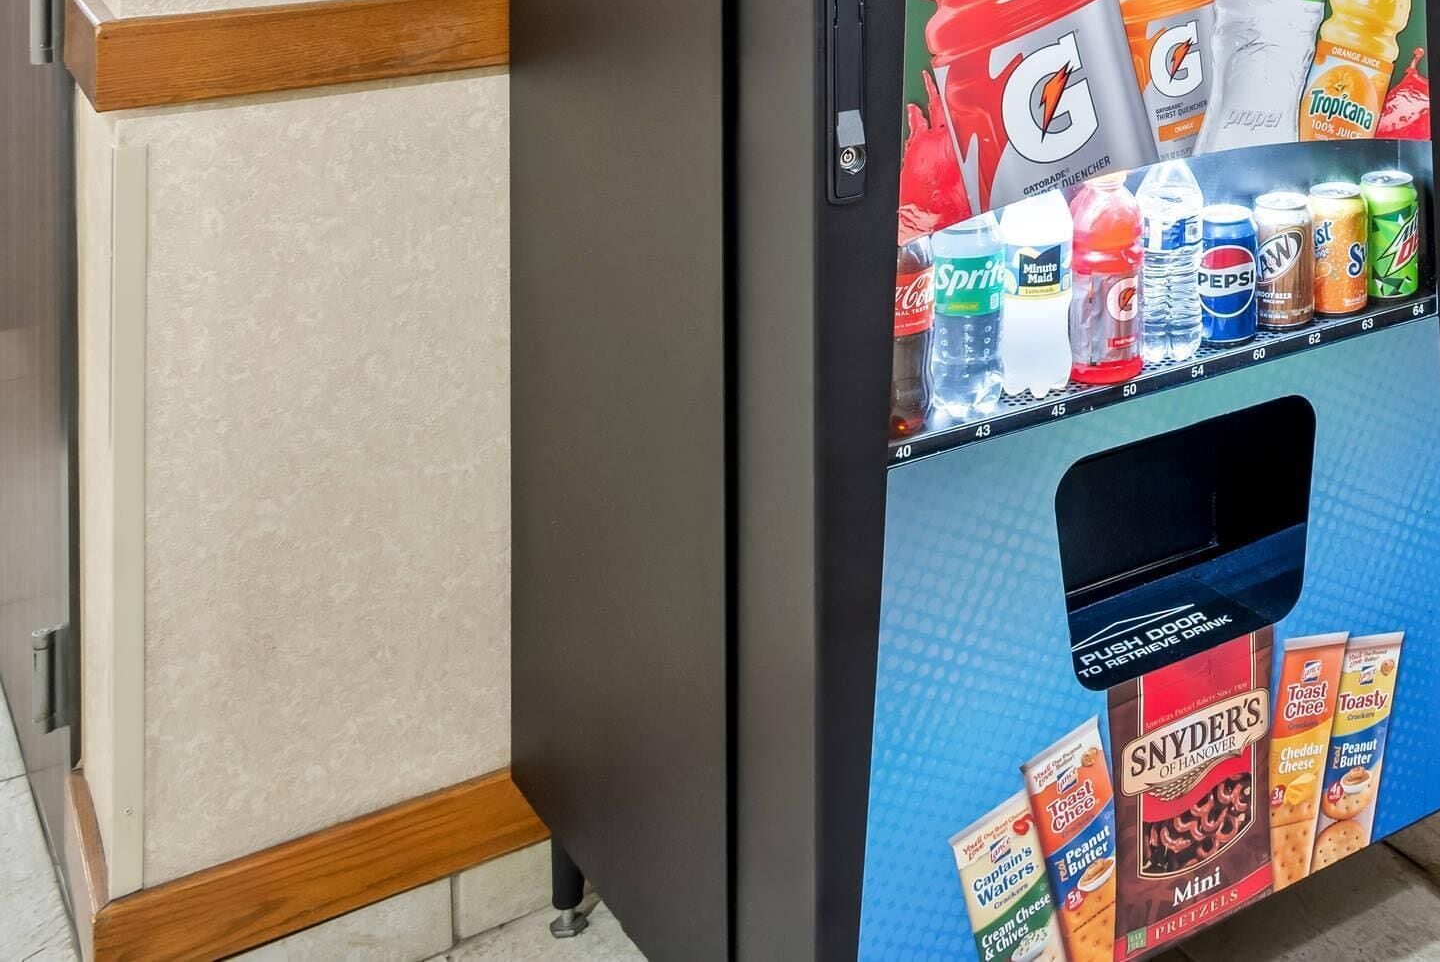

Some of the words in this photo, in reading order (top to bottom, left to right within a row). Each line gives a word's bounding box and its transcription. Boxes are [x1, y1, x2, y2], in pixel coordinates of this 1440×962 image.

[1331, 46, 1360, 62] ORANGE
[1361, 55, 1381, 69] JUICE
[1001, 30, 1100, 164] G
[1156, 110, 1176, 121] THIRST
[1224, 109, 1282, 129] propel
[1309, 89, 1373, 130] Tropicana
[1311, 119, 1335, 135] 100%
[1336, 127, 1362, 139] JUICE
[1061, 155, 1111, 188] QUENCHER
[1023, 169, 1067, 196] GATORADE
[1023, 263, 1058, 274] Minute
[1027, 273, 1053, 284] Maid
[1198, 270, 1254, 289] PEPSI
[1412, 303, 1425, 316] 64
[1361, 318, 1374, 330] 63
[1308, 333, 1321, 345] 62
[1253, 348, 1266, 360] 60
[1191, 366, 1204, 378] 54
[1123, 385, 1137, 397] 50
[1051, 403, 1066, 417] 45
[975, 425, 991, 438] 43
[895, 445, 912, 459] 40
[1079, 665, 1102, 679] TO
[1107, 635, 1181, 669] RETRIEVE
[1181, 614, 1233, 640] DRINK
[1080, 636, 1143, 666] PUSH
[1146, 611, 1207, 642] DOOR
[1288, 682, 1328, 701] Toast
[1339, 689, 1388, 711] Toasty
[1285, 700, 1324, 719] Chee
[1130, 696, 1262, 777] SNYDER'S
[1159, 763, 1177, 779] OF
[1178, 735, 1236, 774] HANOVER
[1280, 742, 1324, 761] Cheddar
[1342, 738, 1378, 757] Peanut
[1278, 756, 1315, 775] Cheese
[1340, 752, 1373, 769] Butter
[1048, 780, 1093, 817] Toast
[1052, 795, 1096, 832] Chee
[963, 834, 982, 855] You'll
[1065, 824, 1111, 864] Peanut
[973, 846, 1033, 892] Captain's
[1068, 841, 1109, 876] Butter
[977, 861, 1034, 906] Wafers
[1172, 866, 1221, 907] Mini
[994, 883, 1028, 910] Crackers
[981, 919, 1016, 949] Cream
[1015, 893, 1051, 924] Cheese
[1154, 888, 1239, 940] PRETZELS
[984, 947, 995, 962] &
[995, 923, 1029, 953] Chives
